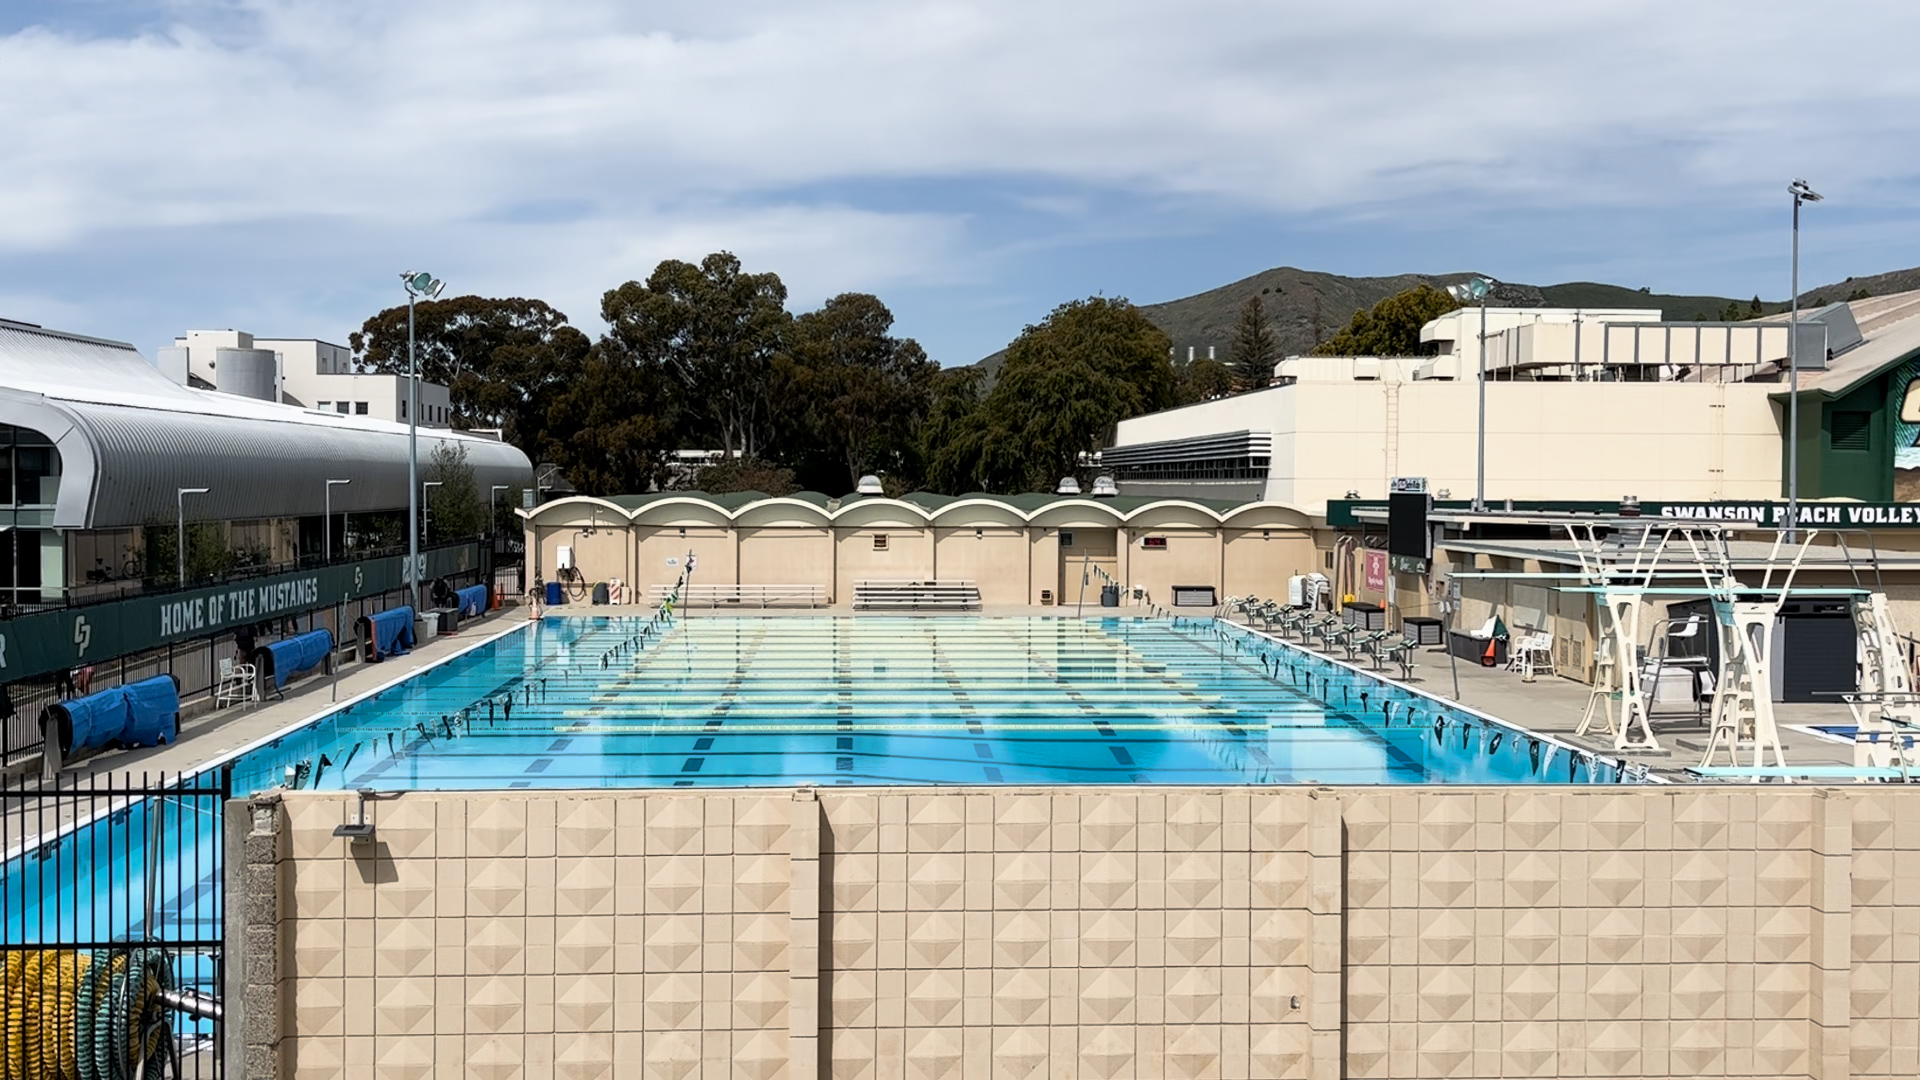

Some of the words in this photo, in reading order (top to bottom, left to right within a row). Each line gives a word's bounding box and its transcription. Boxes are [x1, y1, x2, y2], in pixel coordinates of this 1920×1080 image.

[1661, 507, 1765, 522] SWANSON
[160, 598, 204, 636] HOME
[208, 594, 225, 625] OF
[229, 588, 255, 620] THE
[259, 577, 318, 614] MUSTANGS
